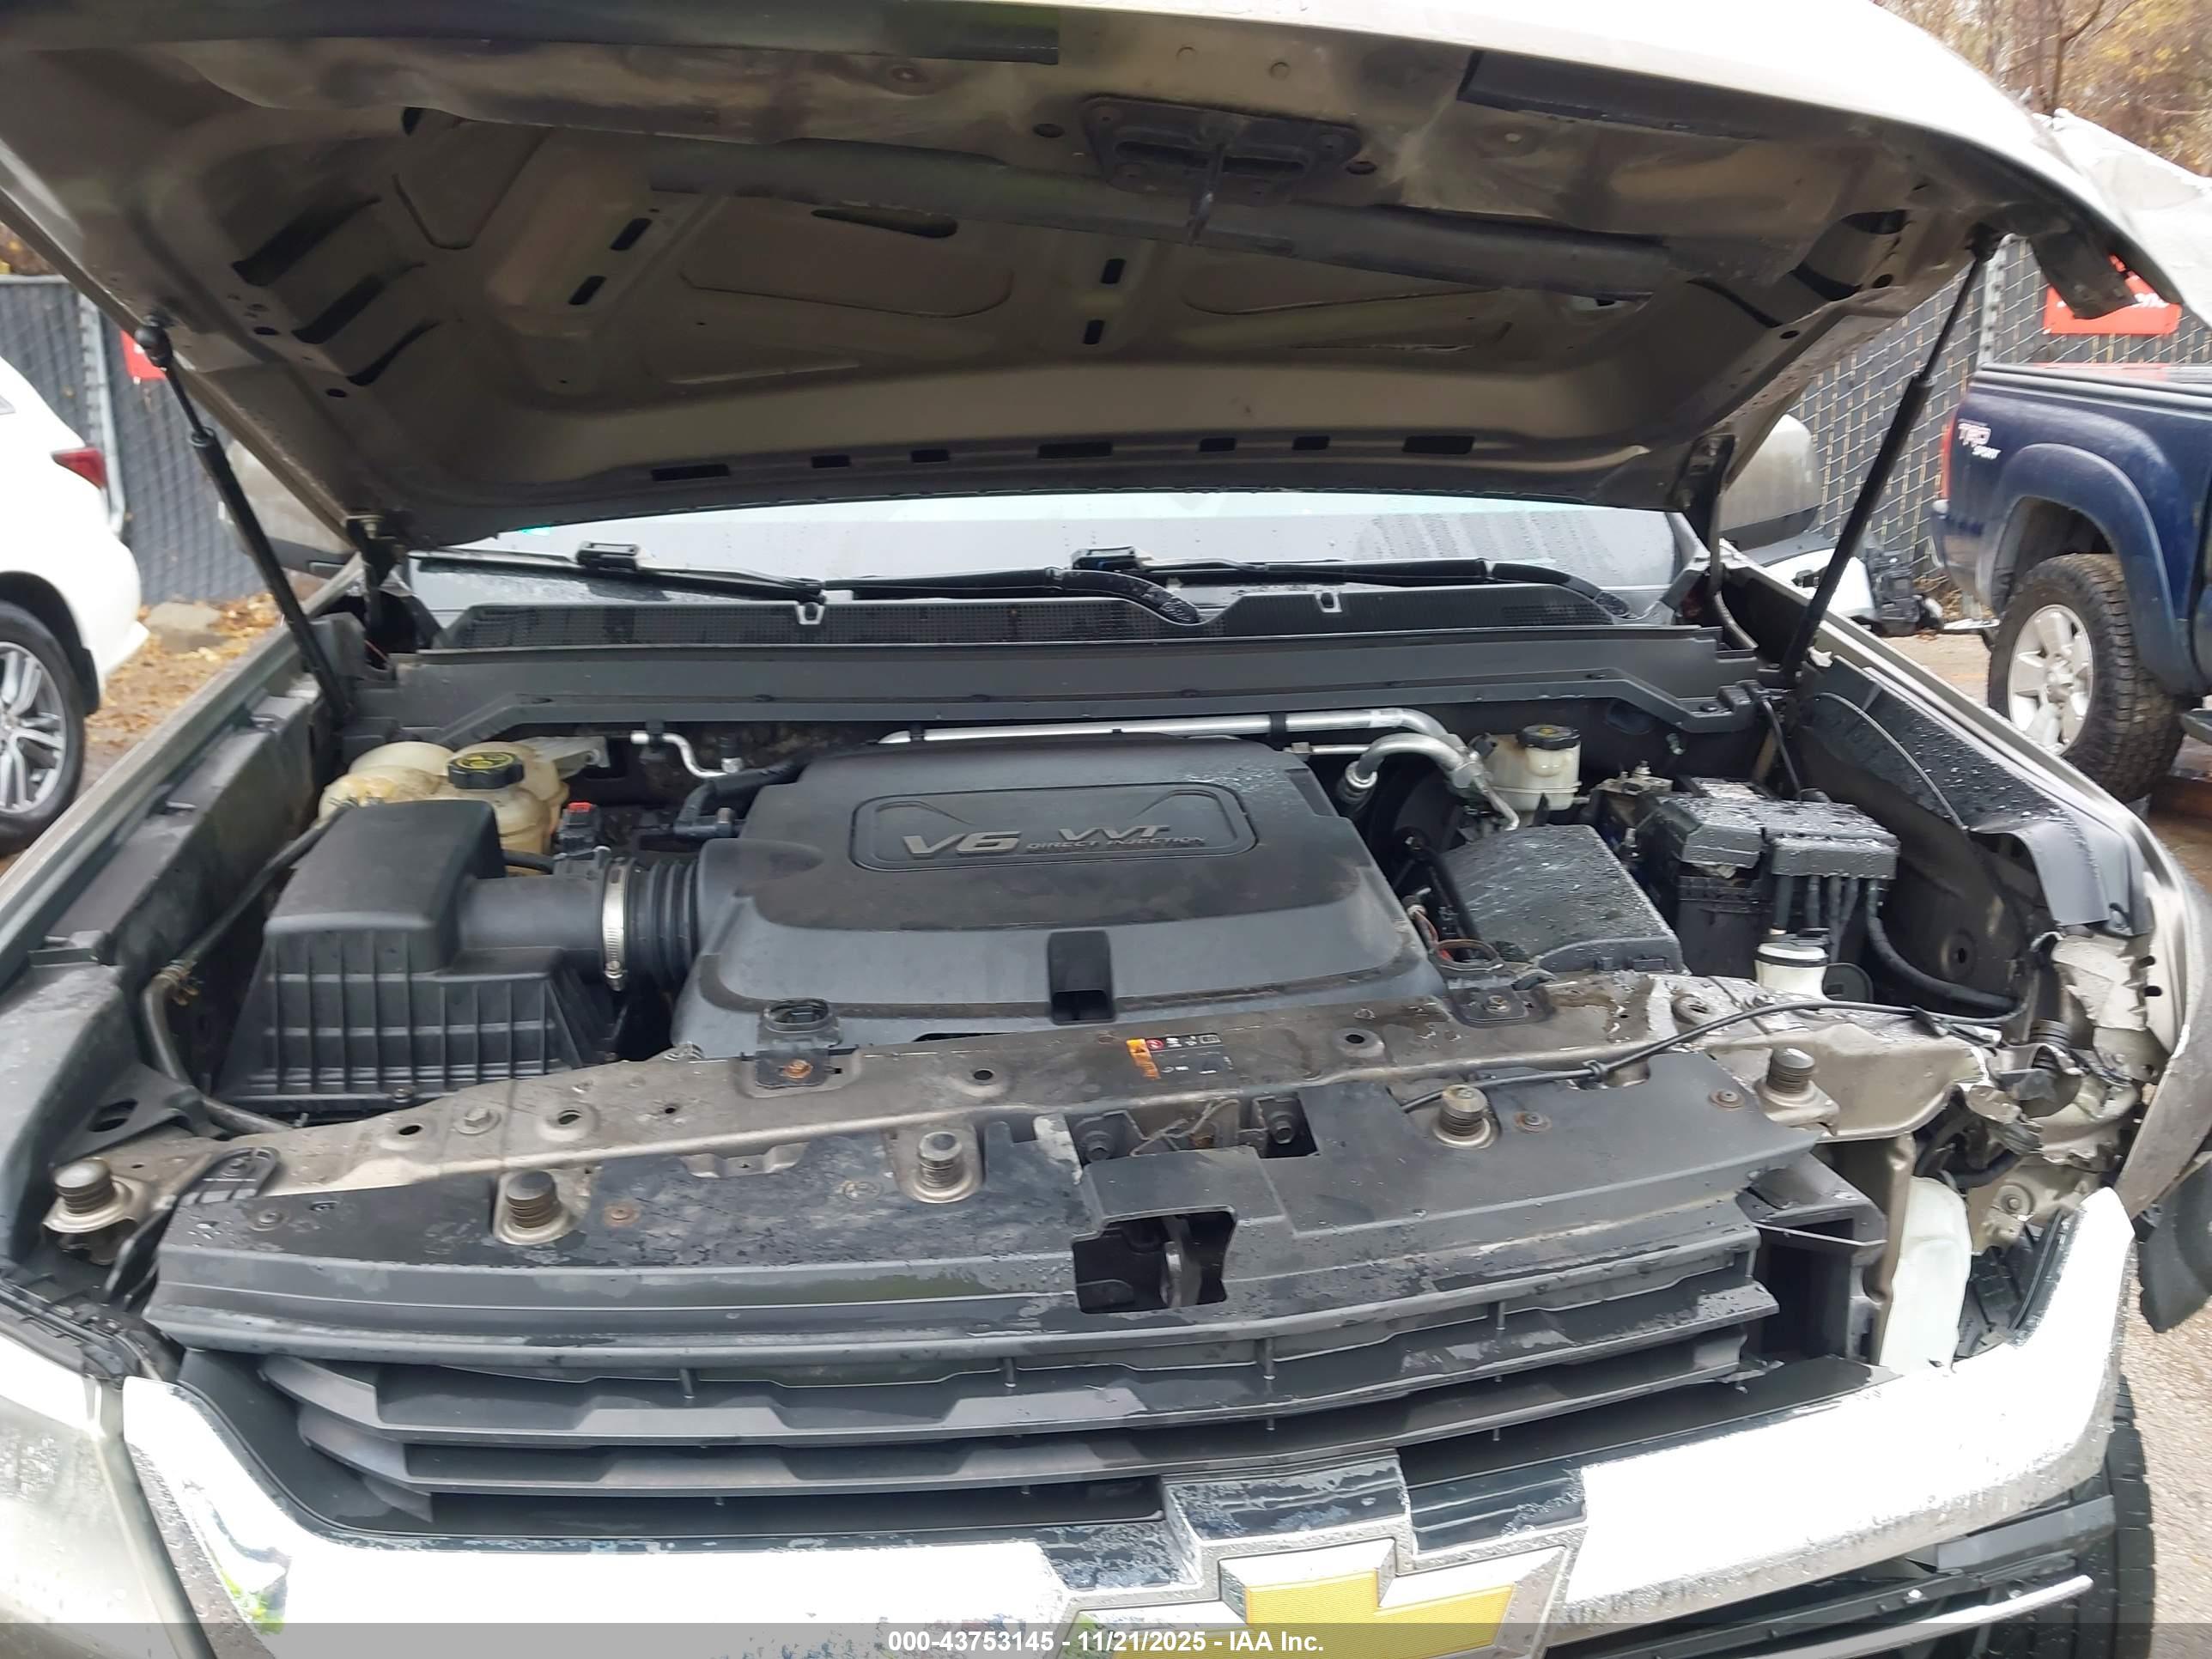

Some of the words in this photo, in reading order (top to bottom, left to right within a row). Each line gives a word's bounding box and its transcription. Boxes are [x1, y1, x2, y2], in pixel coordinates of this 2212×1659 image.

[902, 830, 1021, 859] V6
[1059, 824, 1170, 842] VVT
[1026, 840, 1099, 851] DIRECT
[1106, 836, 1207, 846] INJECTION
